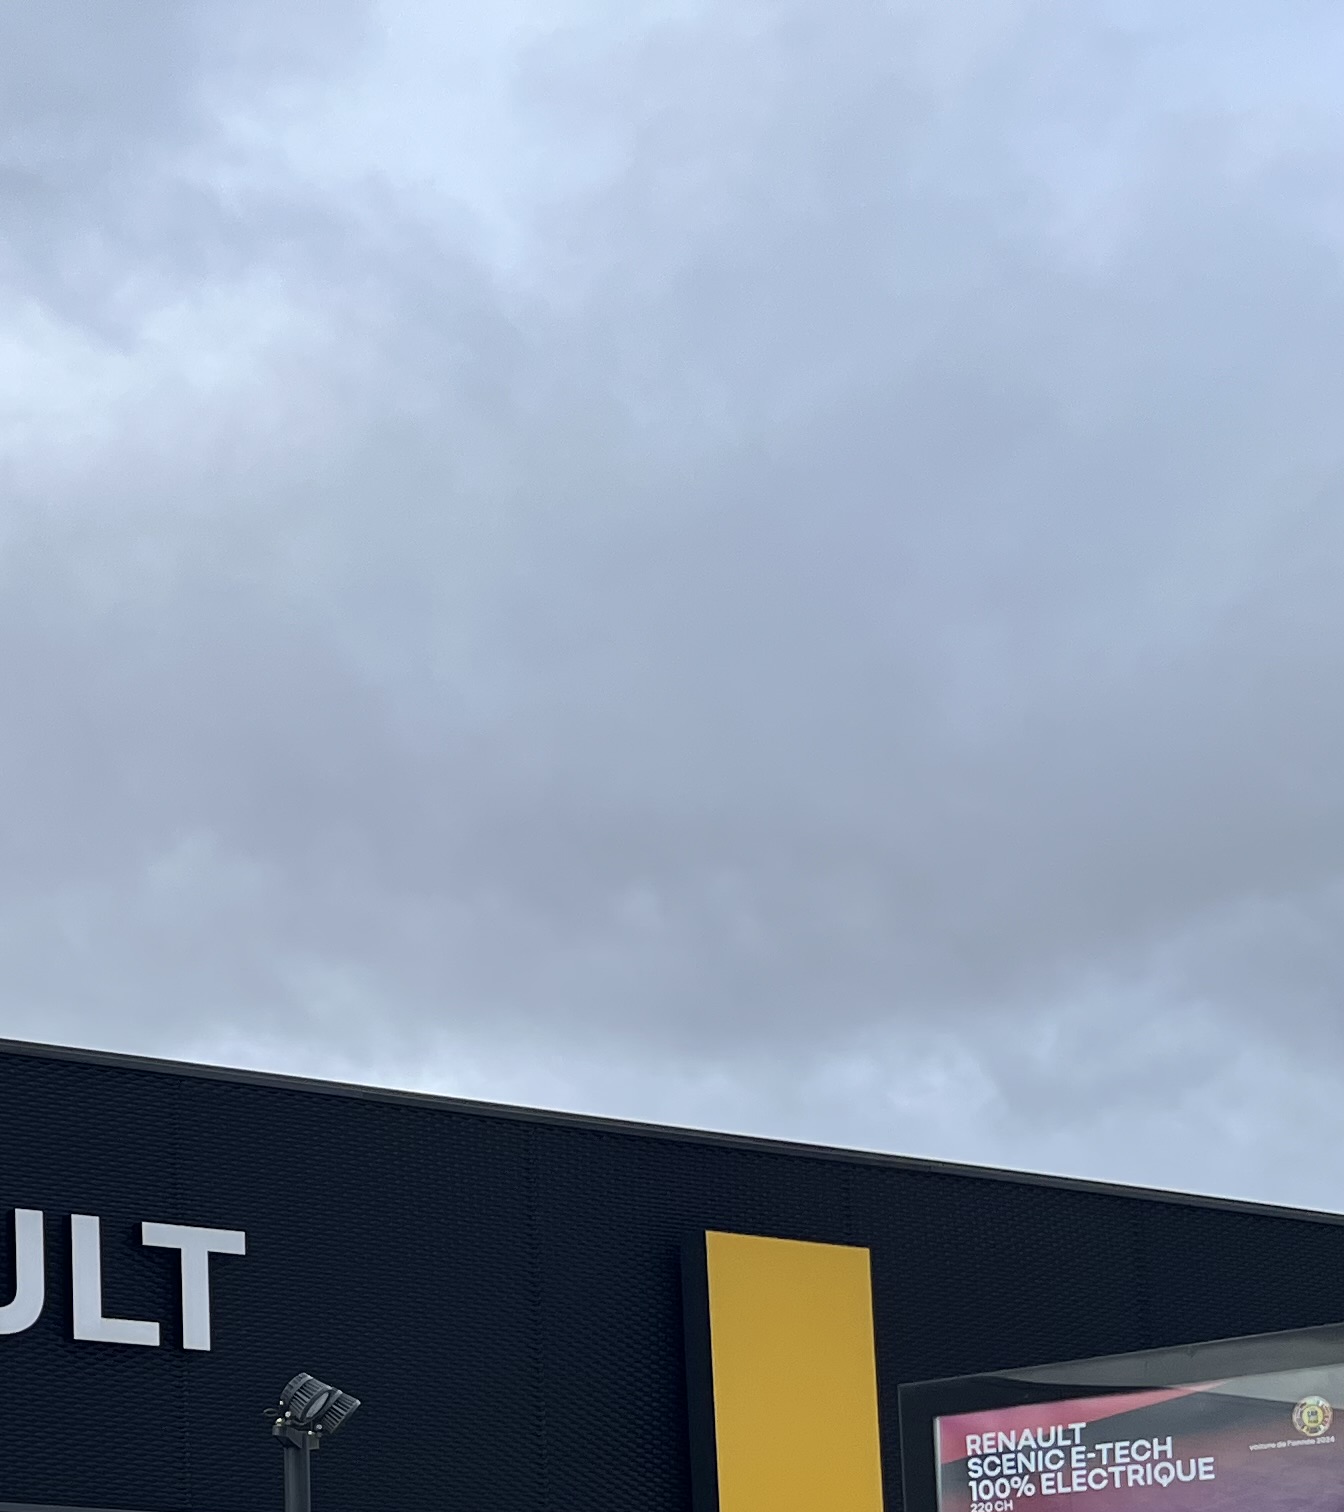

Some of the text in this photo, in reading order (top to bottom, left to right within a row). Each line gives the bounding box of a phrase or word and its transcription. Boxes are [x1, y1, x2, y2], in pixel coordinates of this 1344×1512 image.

[966, 1422, 1086, 1456] RENAULT
[968, 1436, 1173, 1478] SCENIC E-TECH
[968, 1457, 1215, 1501] 100% ELECTRIQUE
[995, 1500, 1013, 1512] CH
